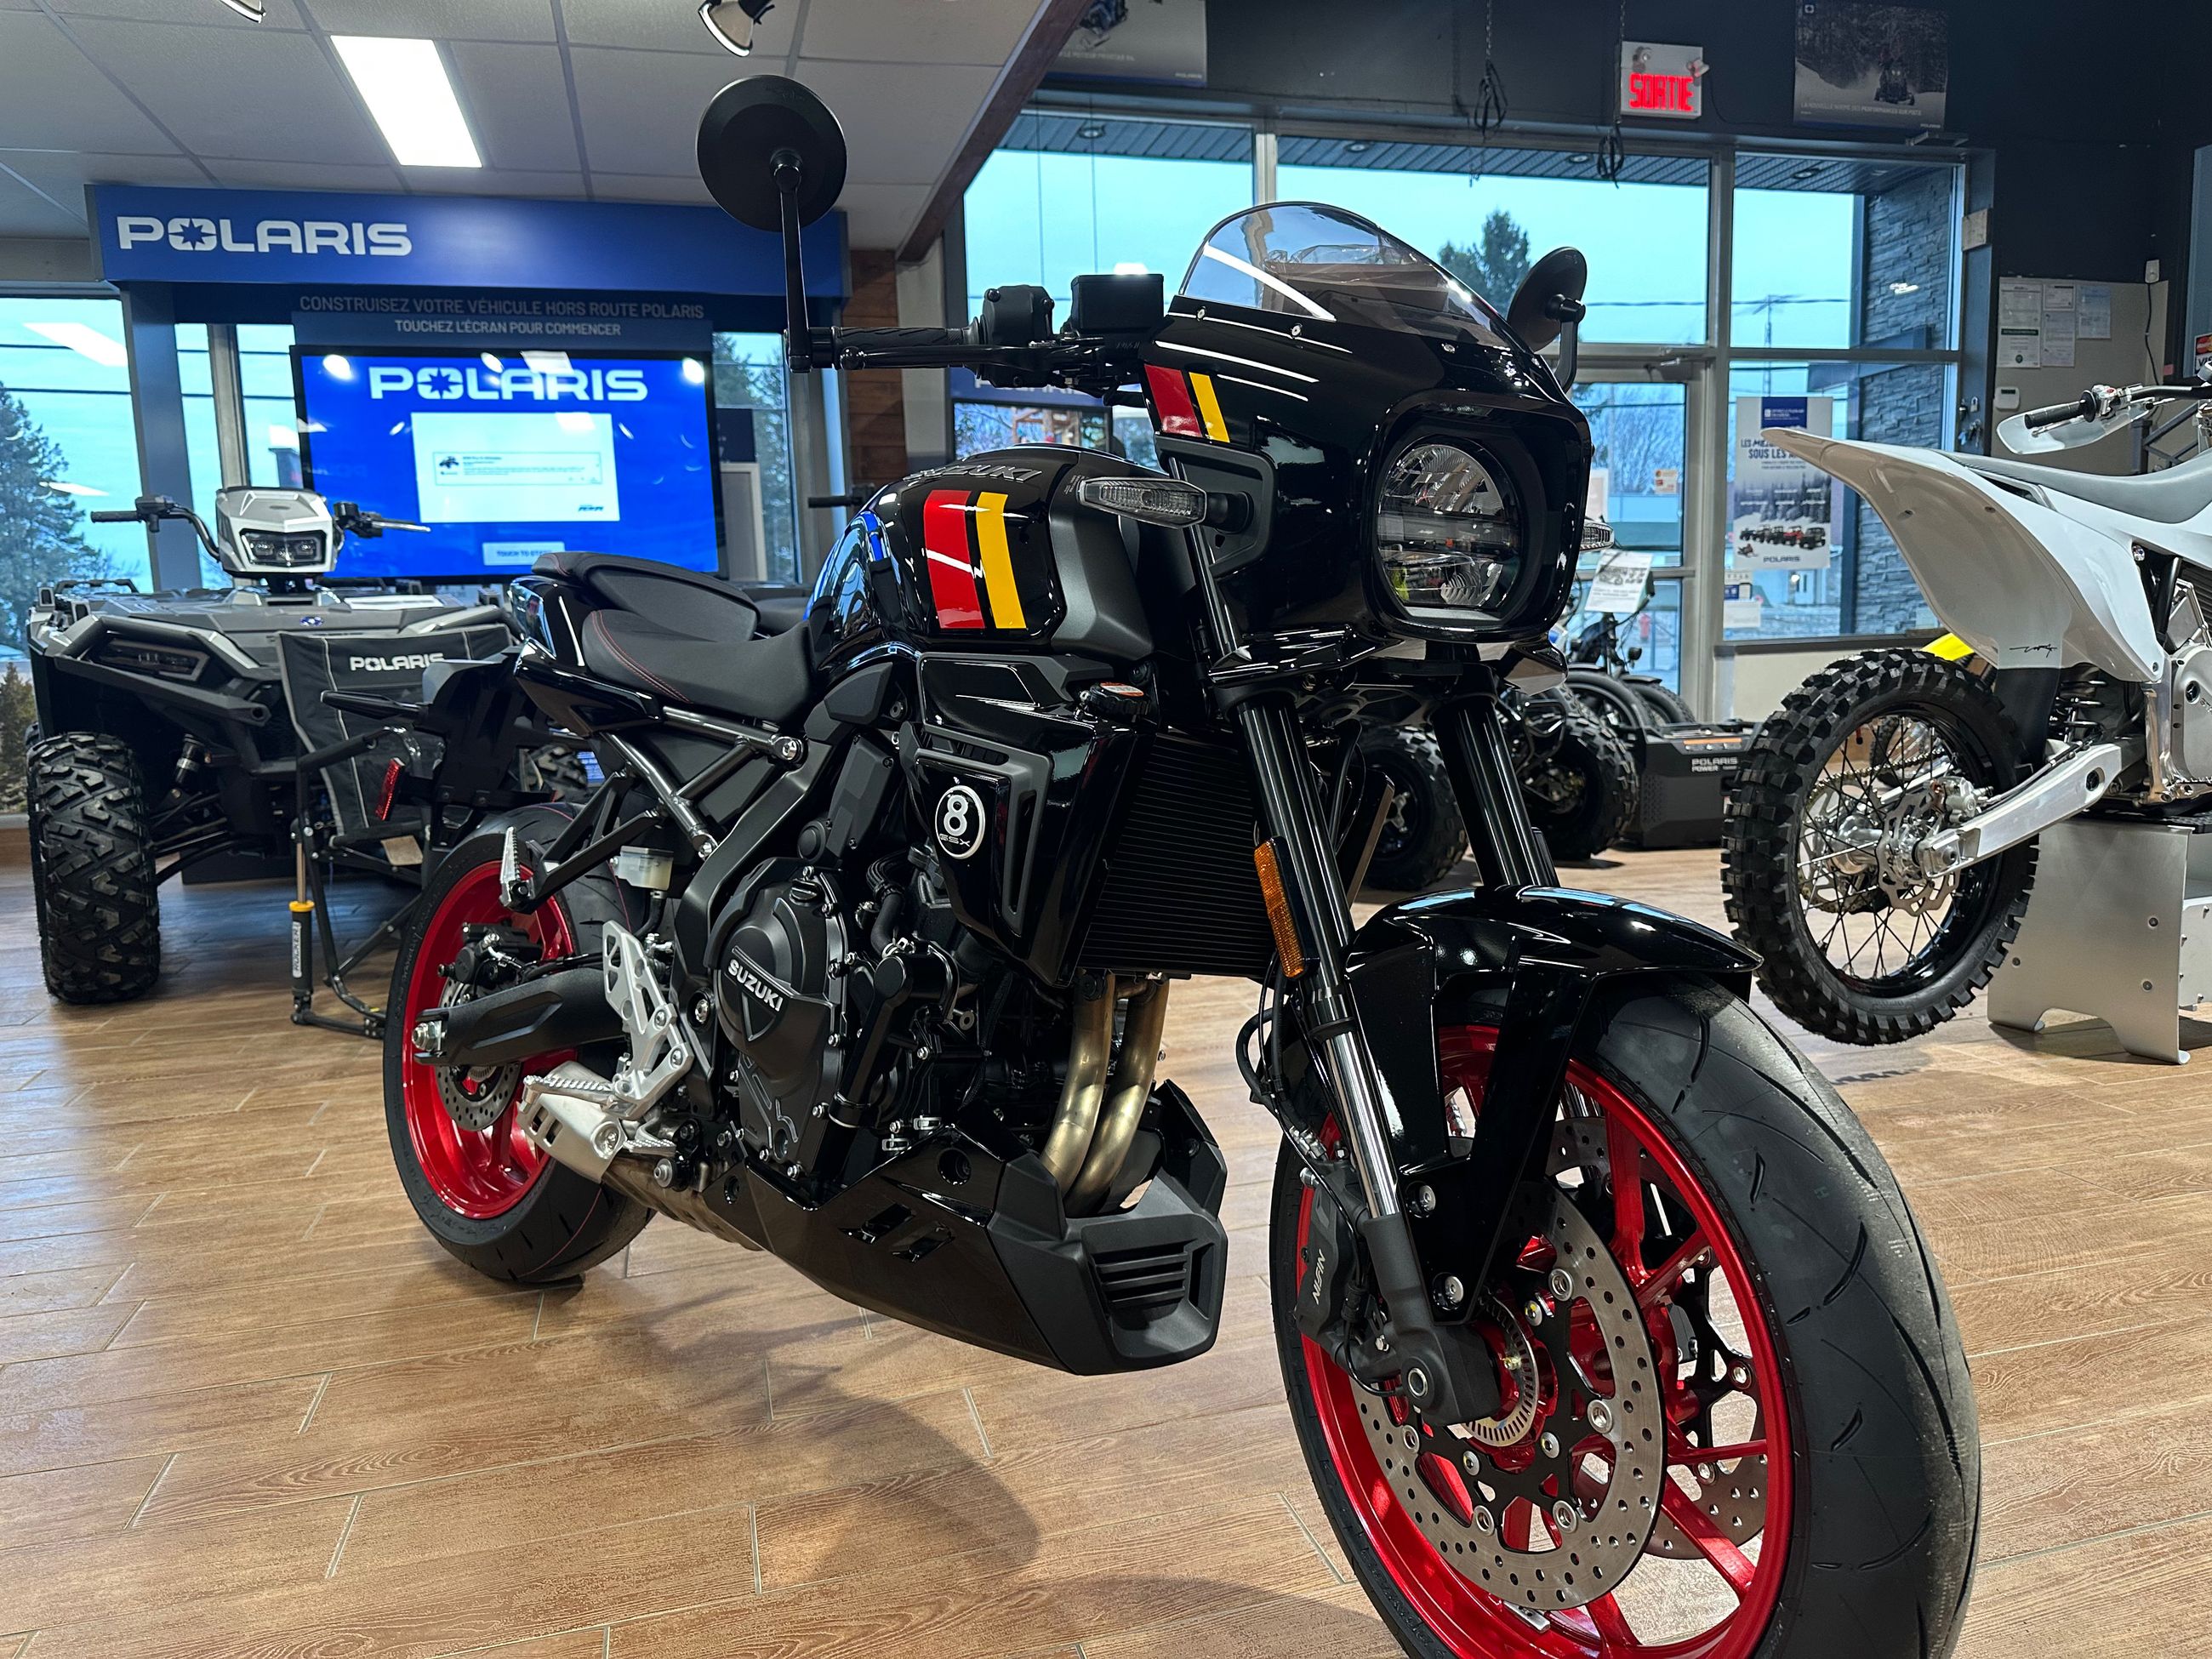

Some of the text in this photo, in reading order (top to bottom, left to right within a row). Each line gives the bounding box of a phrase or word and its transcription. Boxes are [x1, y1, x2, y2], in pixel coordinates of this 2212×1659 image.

[1628, 71, 1694, 111] SORTIE
[117, 216, 413, 256] POLARIS
[299, 296, 704, 318] CONSTRUISEZ VOTRE VÉHICULE HORS ROUTE POLARIS
[395, 319, 453, 333] TOUCHEZ
[510, 322, 544, 334] POUR
[545, 322, 621, 336] COMMENCER
[368, 367, 648, 402] POLARIS
[1748, 448, 1769, 459] SOUS
[1772, 448, 1786, 459] LES
[350, 653, 444, 671] POLARIS
[1691, 757, 1738, 766] POLARIS
[944, 794, 968, 837] 8
[939, 833, 971, 847] GSX
[727, 959, 784, 1012] SUZUKI
